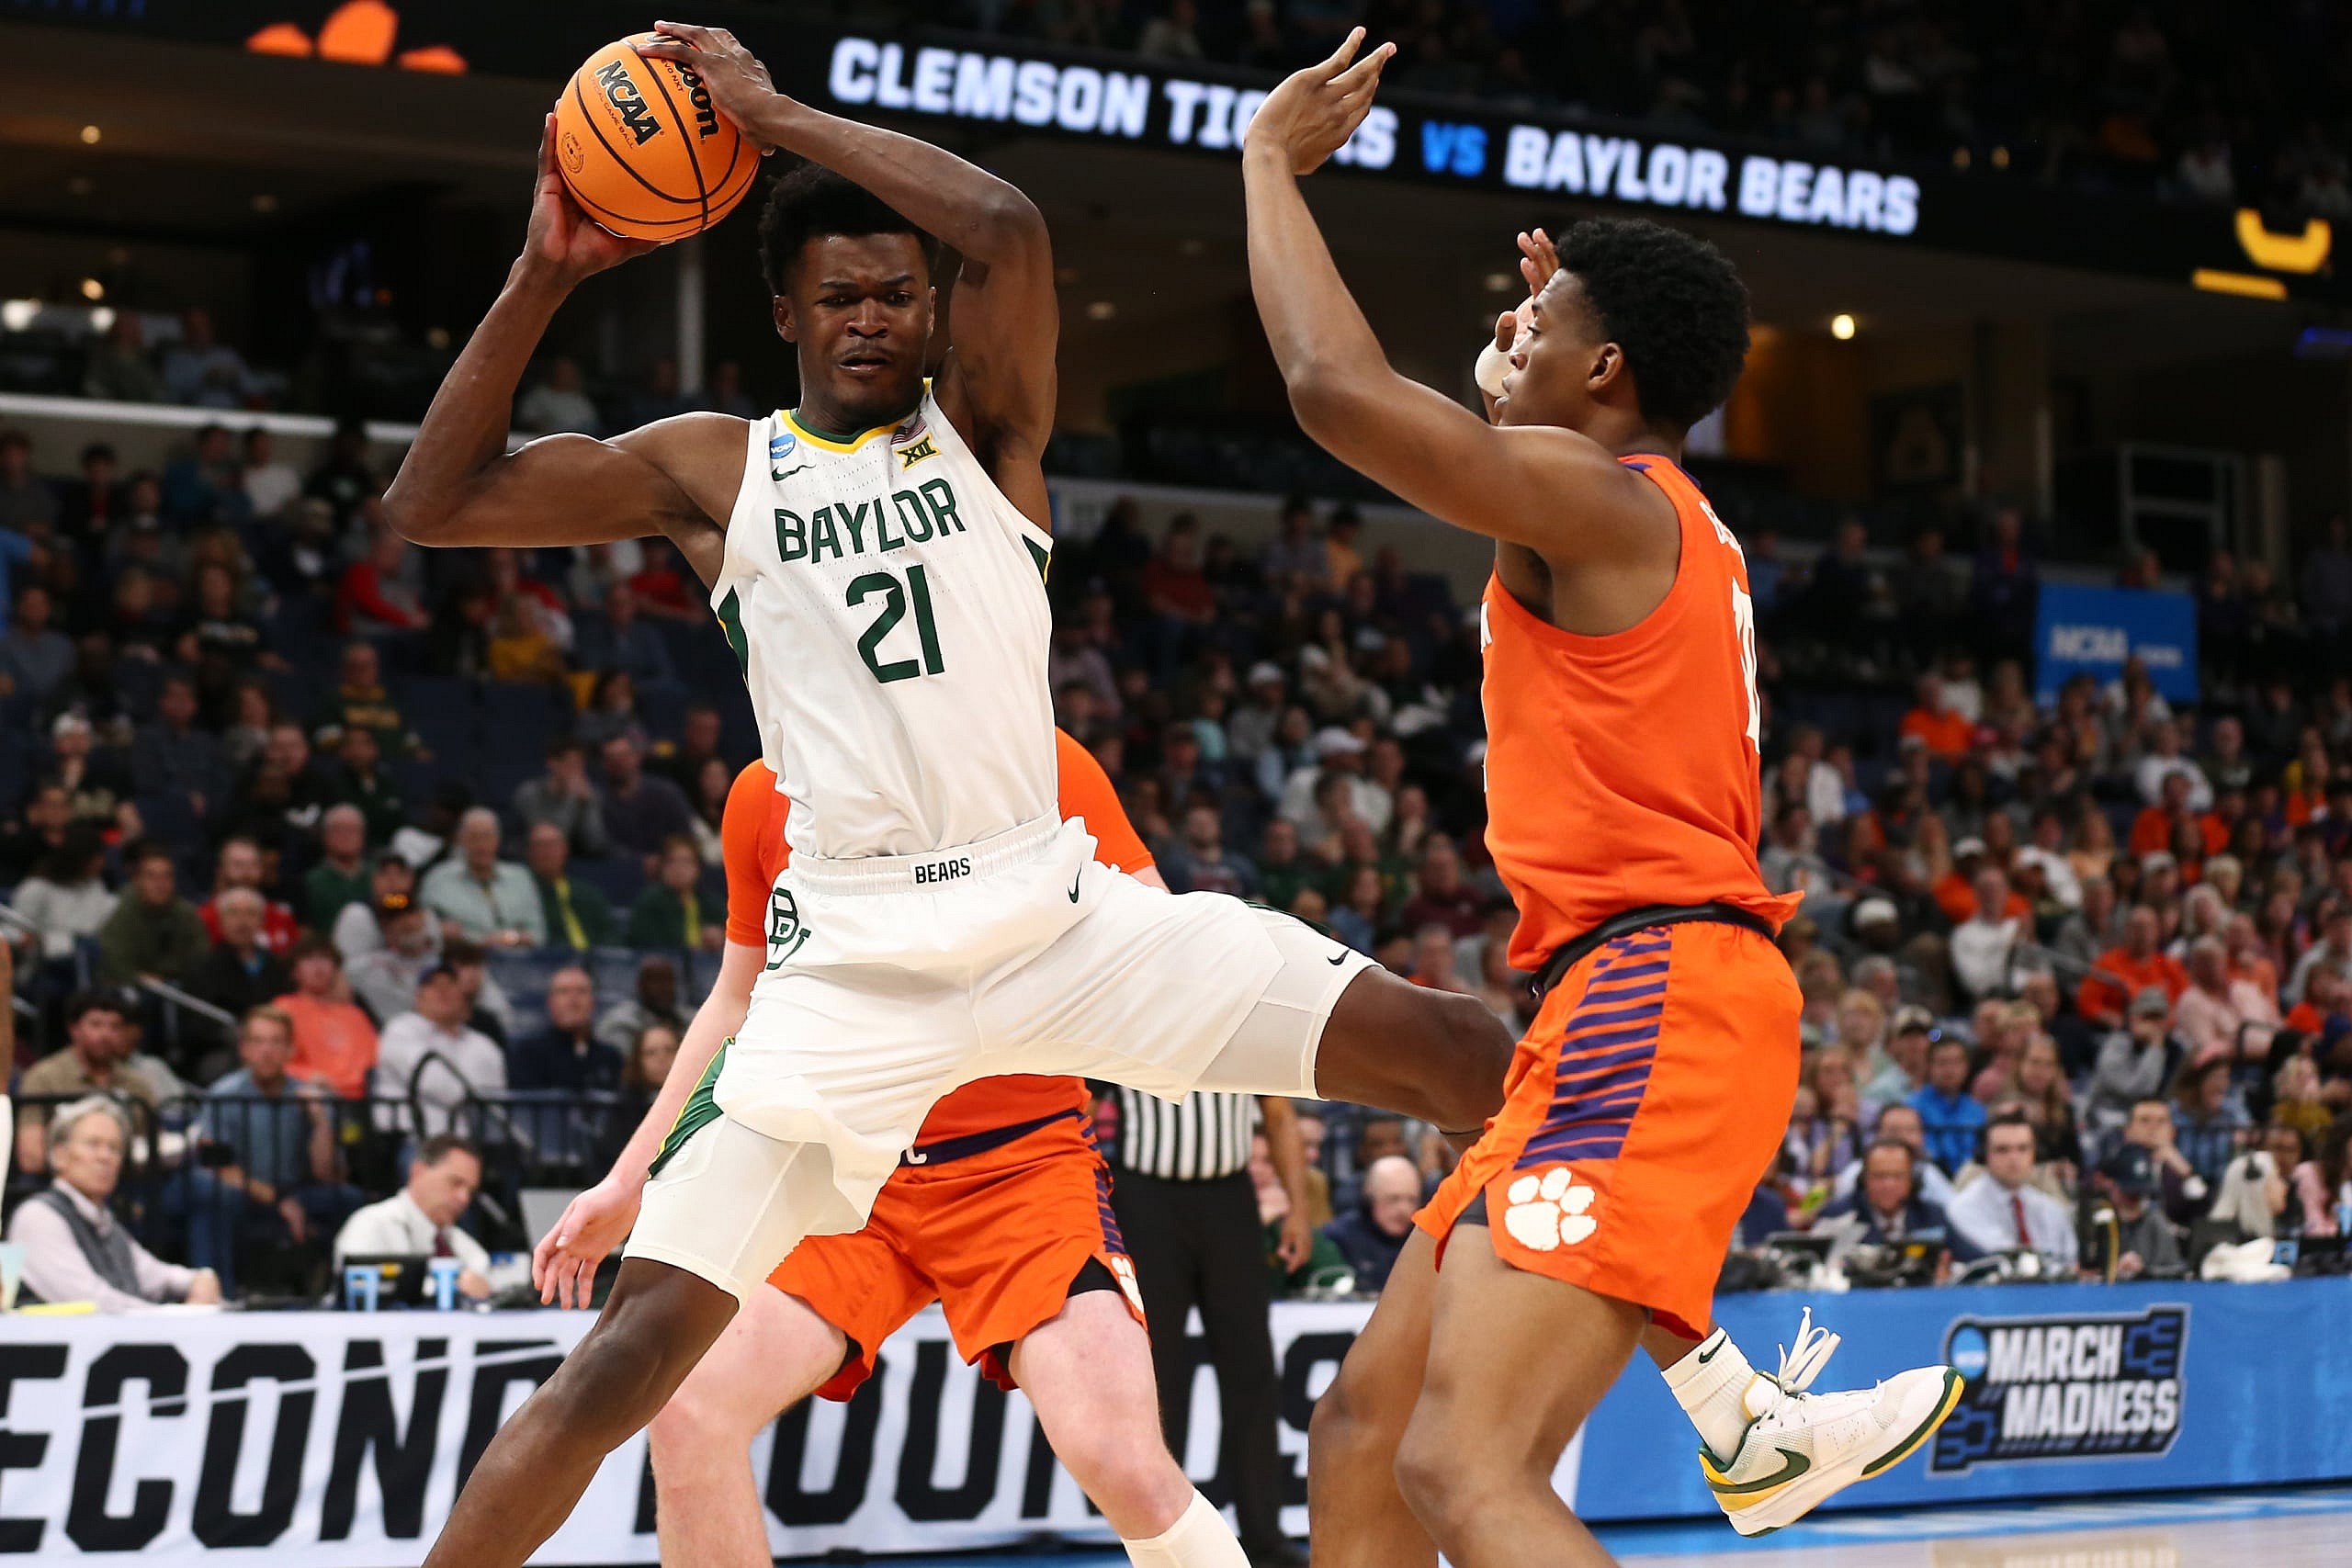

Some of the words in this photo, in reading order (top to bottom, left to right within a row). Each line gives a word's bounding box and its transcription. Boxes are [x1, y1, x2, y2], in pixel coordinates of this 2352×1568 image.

[594, 59, 662, 146] NCAA
[829, 37, 1151, 140] CLEMSON
[1164, 79, 1400, 170] TIS
[1420, 120, 1488, 177] VS
[1503, 124, 1730, 212] BAYLOR
[1738, 155, 1921, 237] BEARS
[775, 478, 967, 564] BAYLOR
[845, 564, 945, 683] 21
[915, 857, 971, 884] BEARS
[1986, 1324, 2124, 1382] MARCH
[2002, 1379, 2178, 1440] MADNESS
